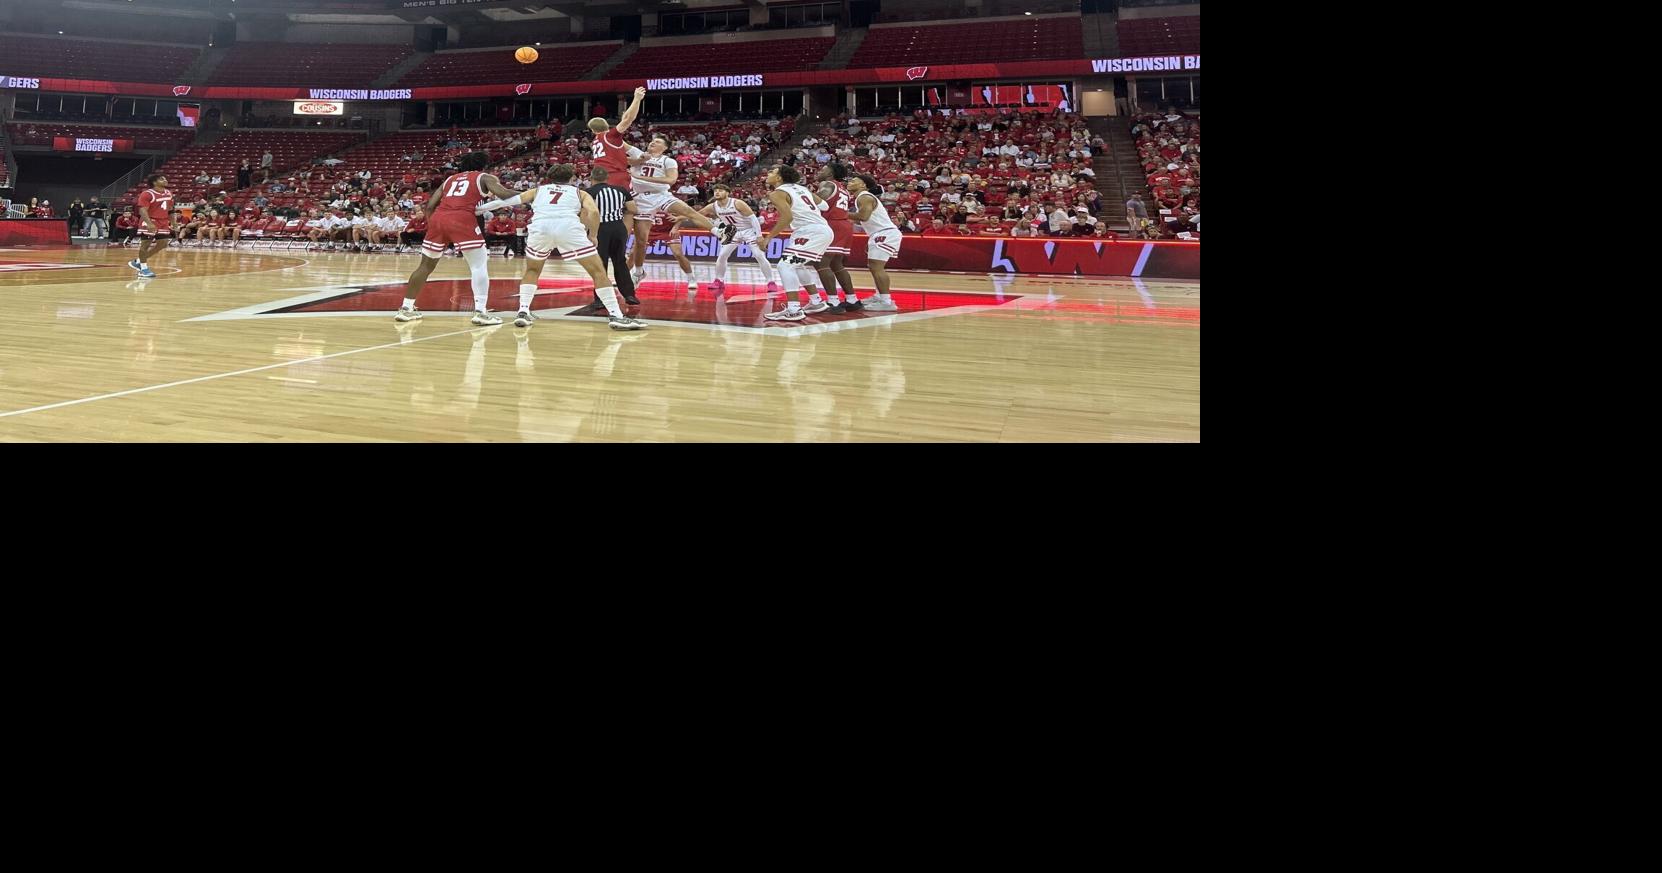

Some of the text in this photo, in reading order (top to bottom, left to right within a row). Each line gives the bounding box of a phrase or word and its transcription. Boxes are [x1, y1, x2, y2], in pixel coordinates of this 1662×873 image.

[1092, 56, 1181, 73] WISCONSIN
[647, 74, 763, 90] WISCONSIN BADGERS
[309, 88, 412, 99] WISCONSIN BADGERS
[301, 104, 335, 112] COUSINS
[75, 143, 113, 152] BADGERS
[592, 142, 606, 159] 22
[641, 166, 655, 177] 31
[446, 180, 470, 197] 13
[549, 190, 563, 204] 7
[801, 194, 816, 210] 9
[160, 200, 167, 210] 4
[725, 215, 738, 225] 11
